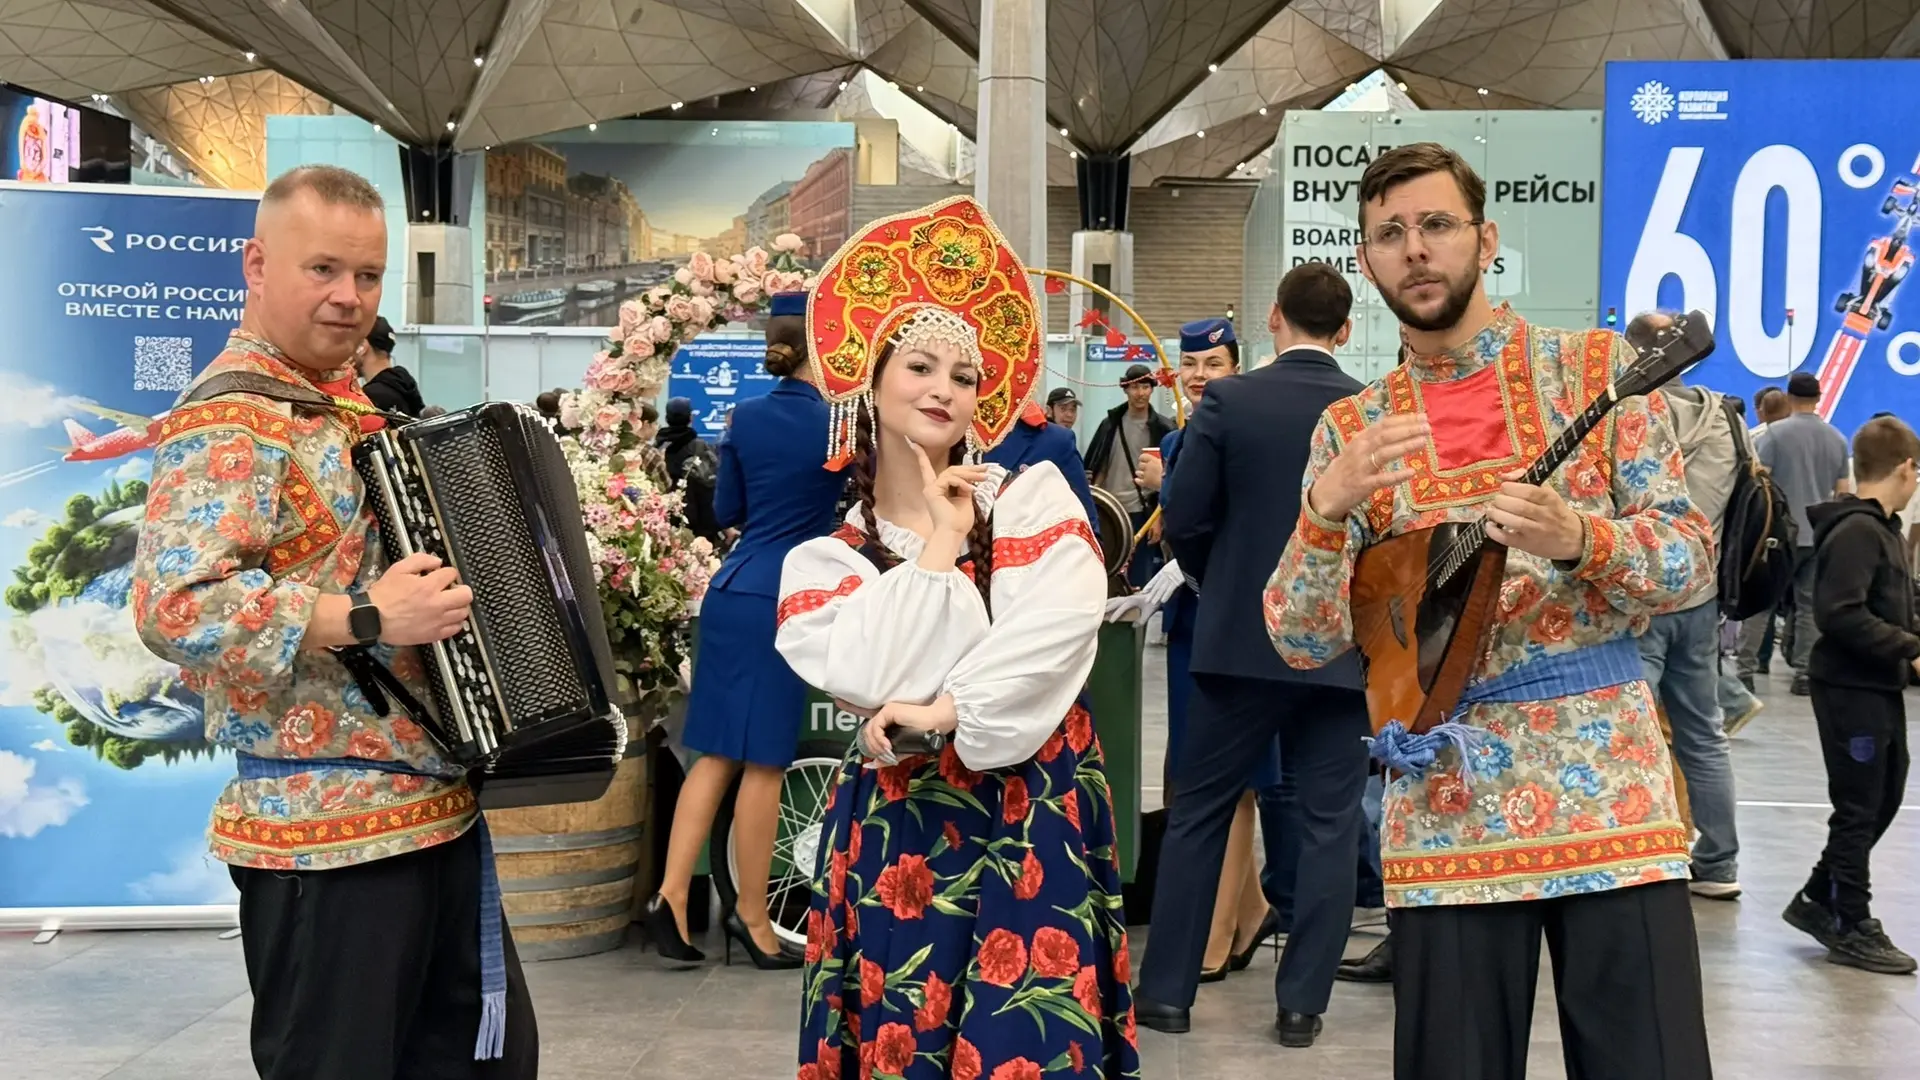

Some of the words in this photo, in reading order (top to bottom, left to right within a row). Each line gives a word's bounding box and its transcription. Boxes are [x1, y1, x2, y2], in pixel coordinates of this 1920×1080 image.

[1293, 145, 1392, 167] ПОСА
[1293, 180, 1361, 202] ВНУТ
[1495, 174, 1595, 203] РЕЙСЫ
[126, 233, 248, 253] РОССИЯ
[1293, 228, 1362, 246] BOARD
[57, 282, 160, 299] ОТКРОЙ
[164, 286, 249, 302] РОССИ
[65, 302, 160, 319] ВМЕСТЕ
[165, 305, 181, 319] С
[683, 362, 691, 373] 1
[755, 362, 764, 374] 2
[811, 702, 865, 731] Пе
